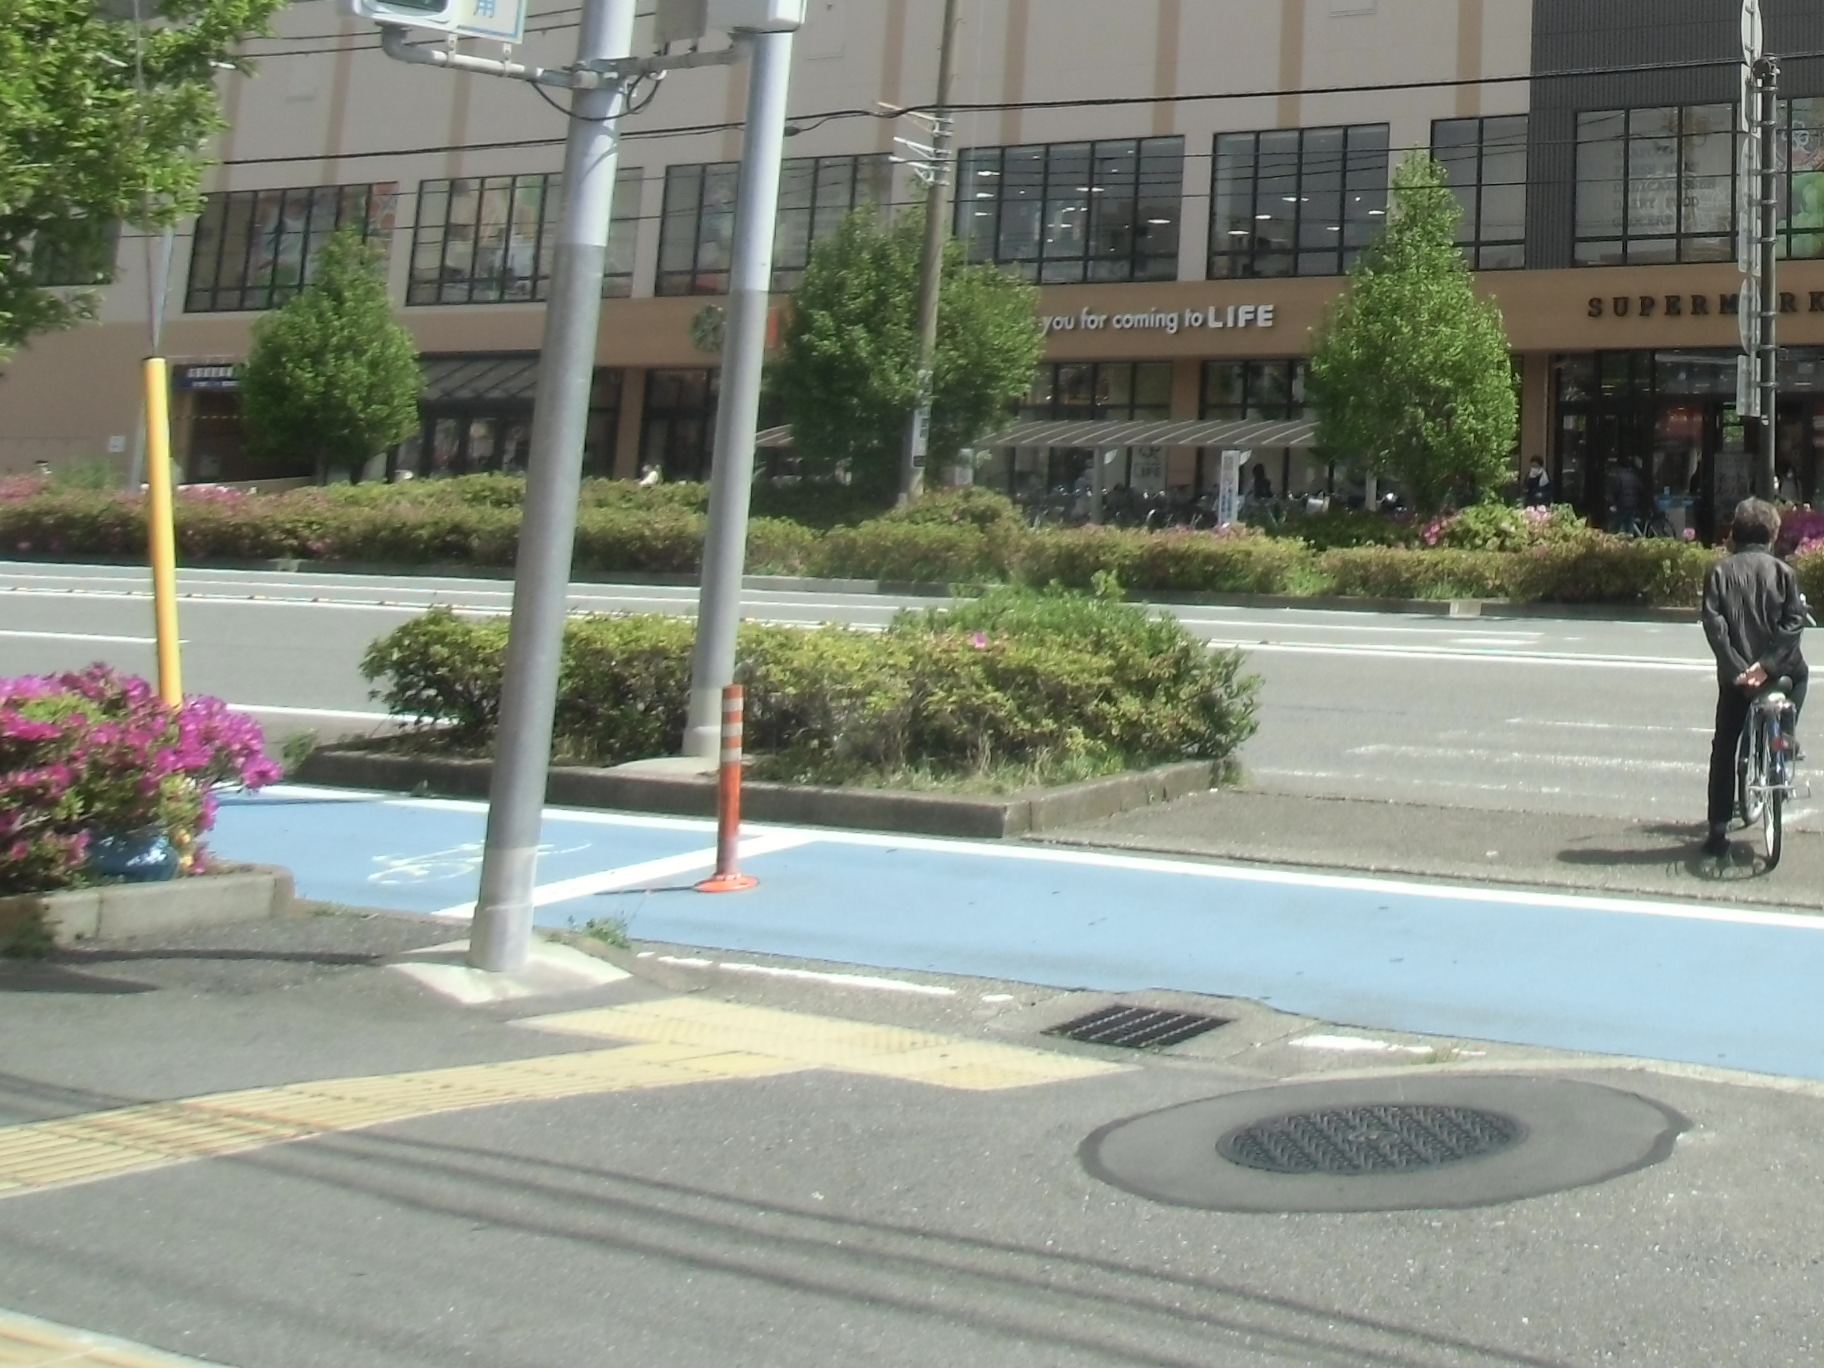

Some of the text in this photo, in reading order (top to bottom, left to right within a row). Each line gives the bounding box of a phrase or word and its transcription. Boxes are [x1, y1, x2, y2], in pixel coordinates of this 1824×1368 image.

[1041, 304, 1275, 338] you for coming to LIFE
